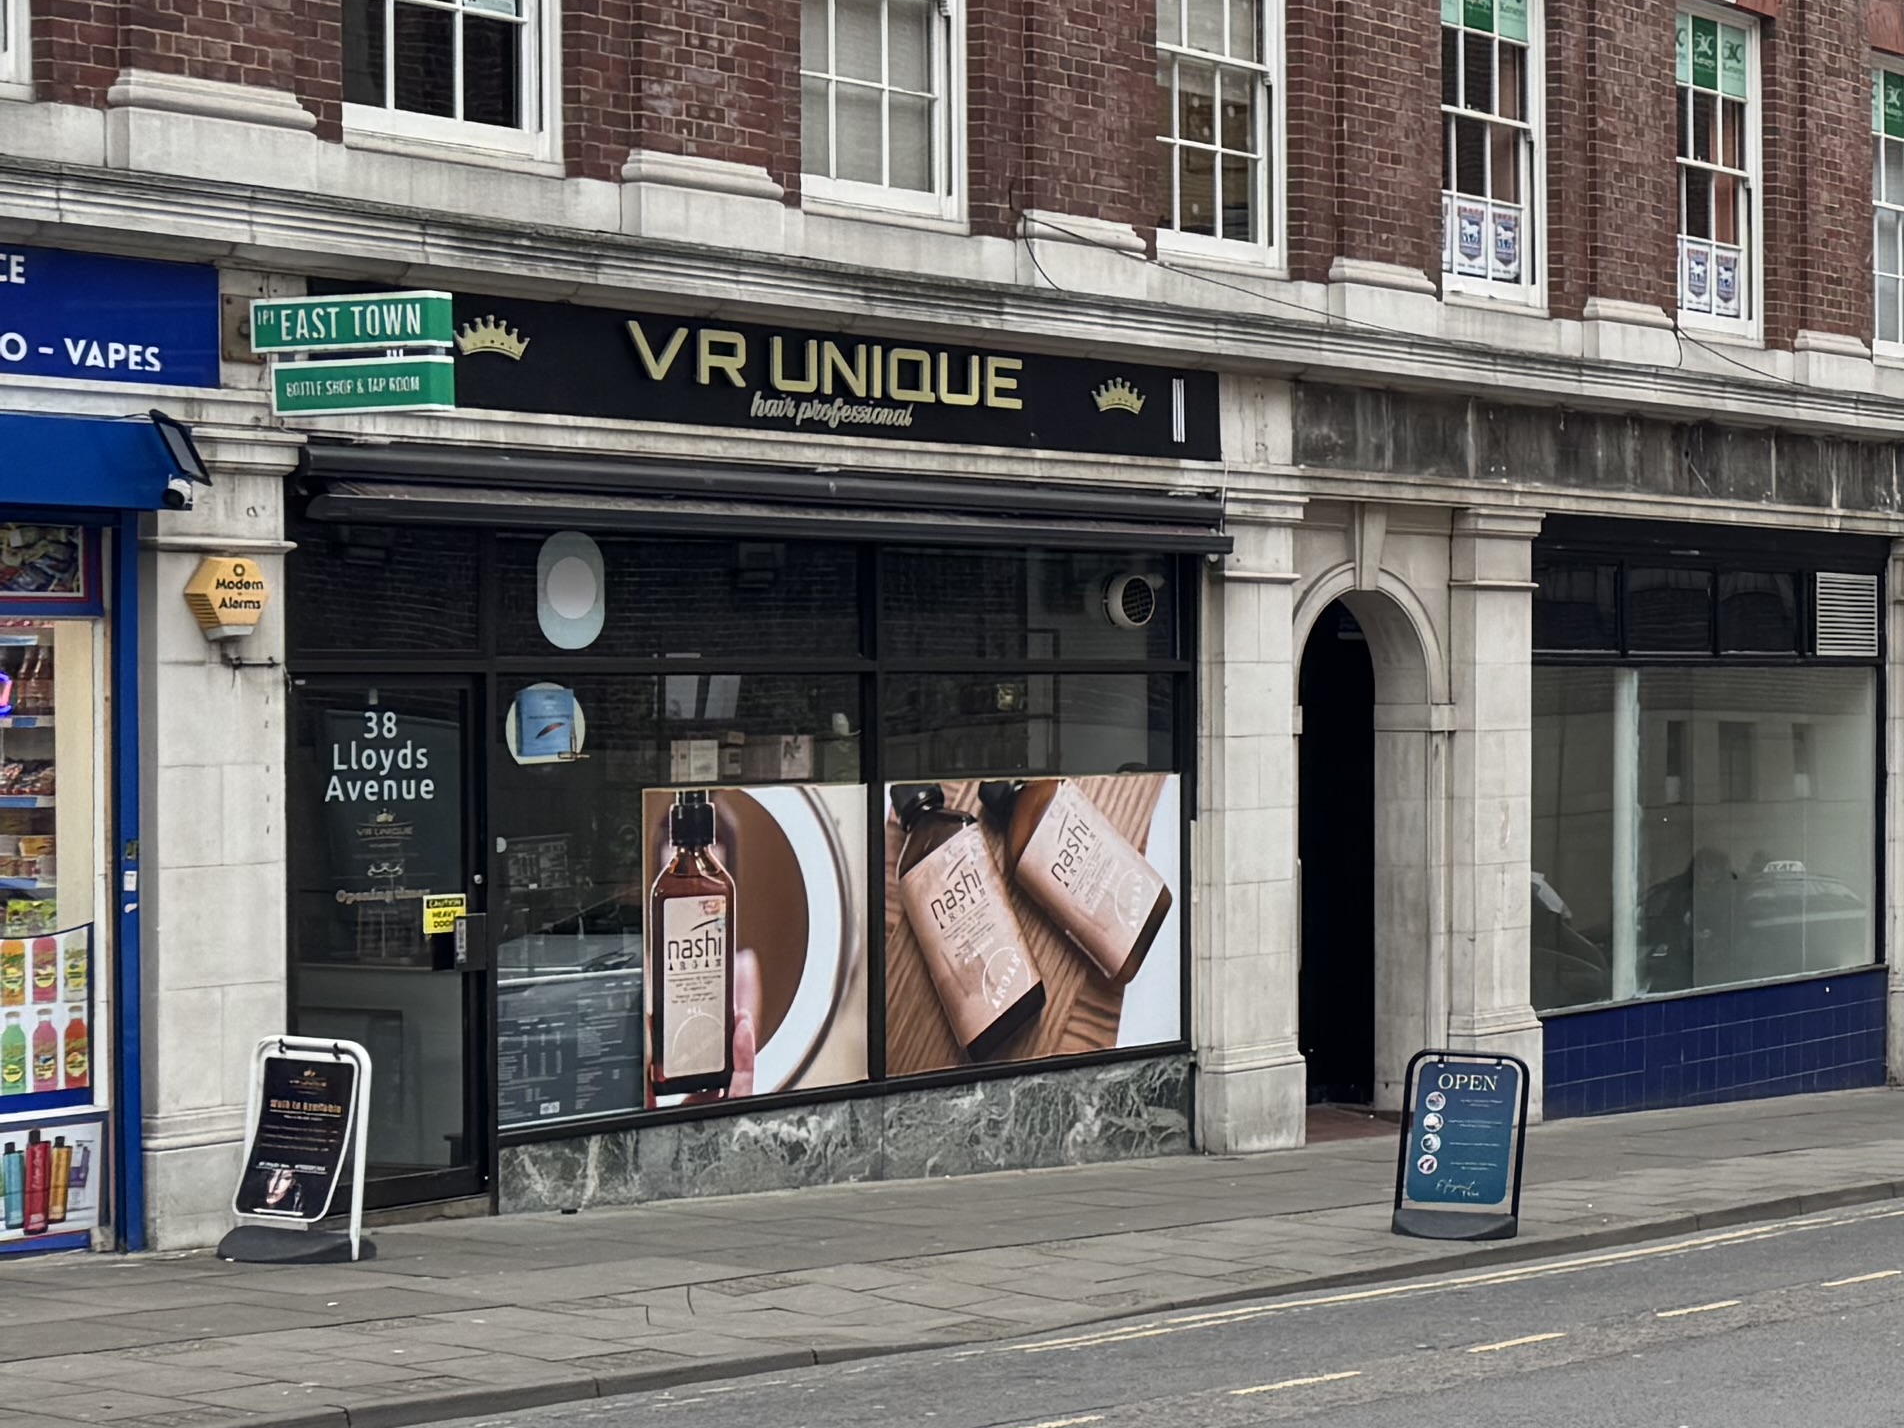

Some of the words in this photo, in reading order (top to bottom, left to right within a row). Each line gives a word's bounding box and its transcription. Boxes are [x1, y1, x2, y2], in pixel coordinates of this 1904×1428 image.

[281, 307, 340, 341] EAST
[350, 303, 421, 337] TOWN
[63, 337, 162, 372] VAPES
[625, 320, 746, 388] VR
[770, 335, 1023, 410] UNIQUE
[286, 380, 323, 398] BOTTLE
[326, 379, 353, 395] SHOP
[368, 377, 387, 392] TAP
[389, 375, 420, 392] ROOM
[751, 390, 797, 419] hair
[796, 399, 913, 429] professional
[363, 711, 397, 739] 38
[333, 740, 428, 776] Lloyds
[324, 775, 435, 803] Avenue
[1051, 814, 1090, 884] nashi
[336, 888, 394, 904] Opening
[930, 861, 982, 922] nashi
[432, 910, 458, 919] HEAVY
[668, 927, 722, 961] nashi
[1438, 1073, 1499, 1091] OPEN
